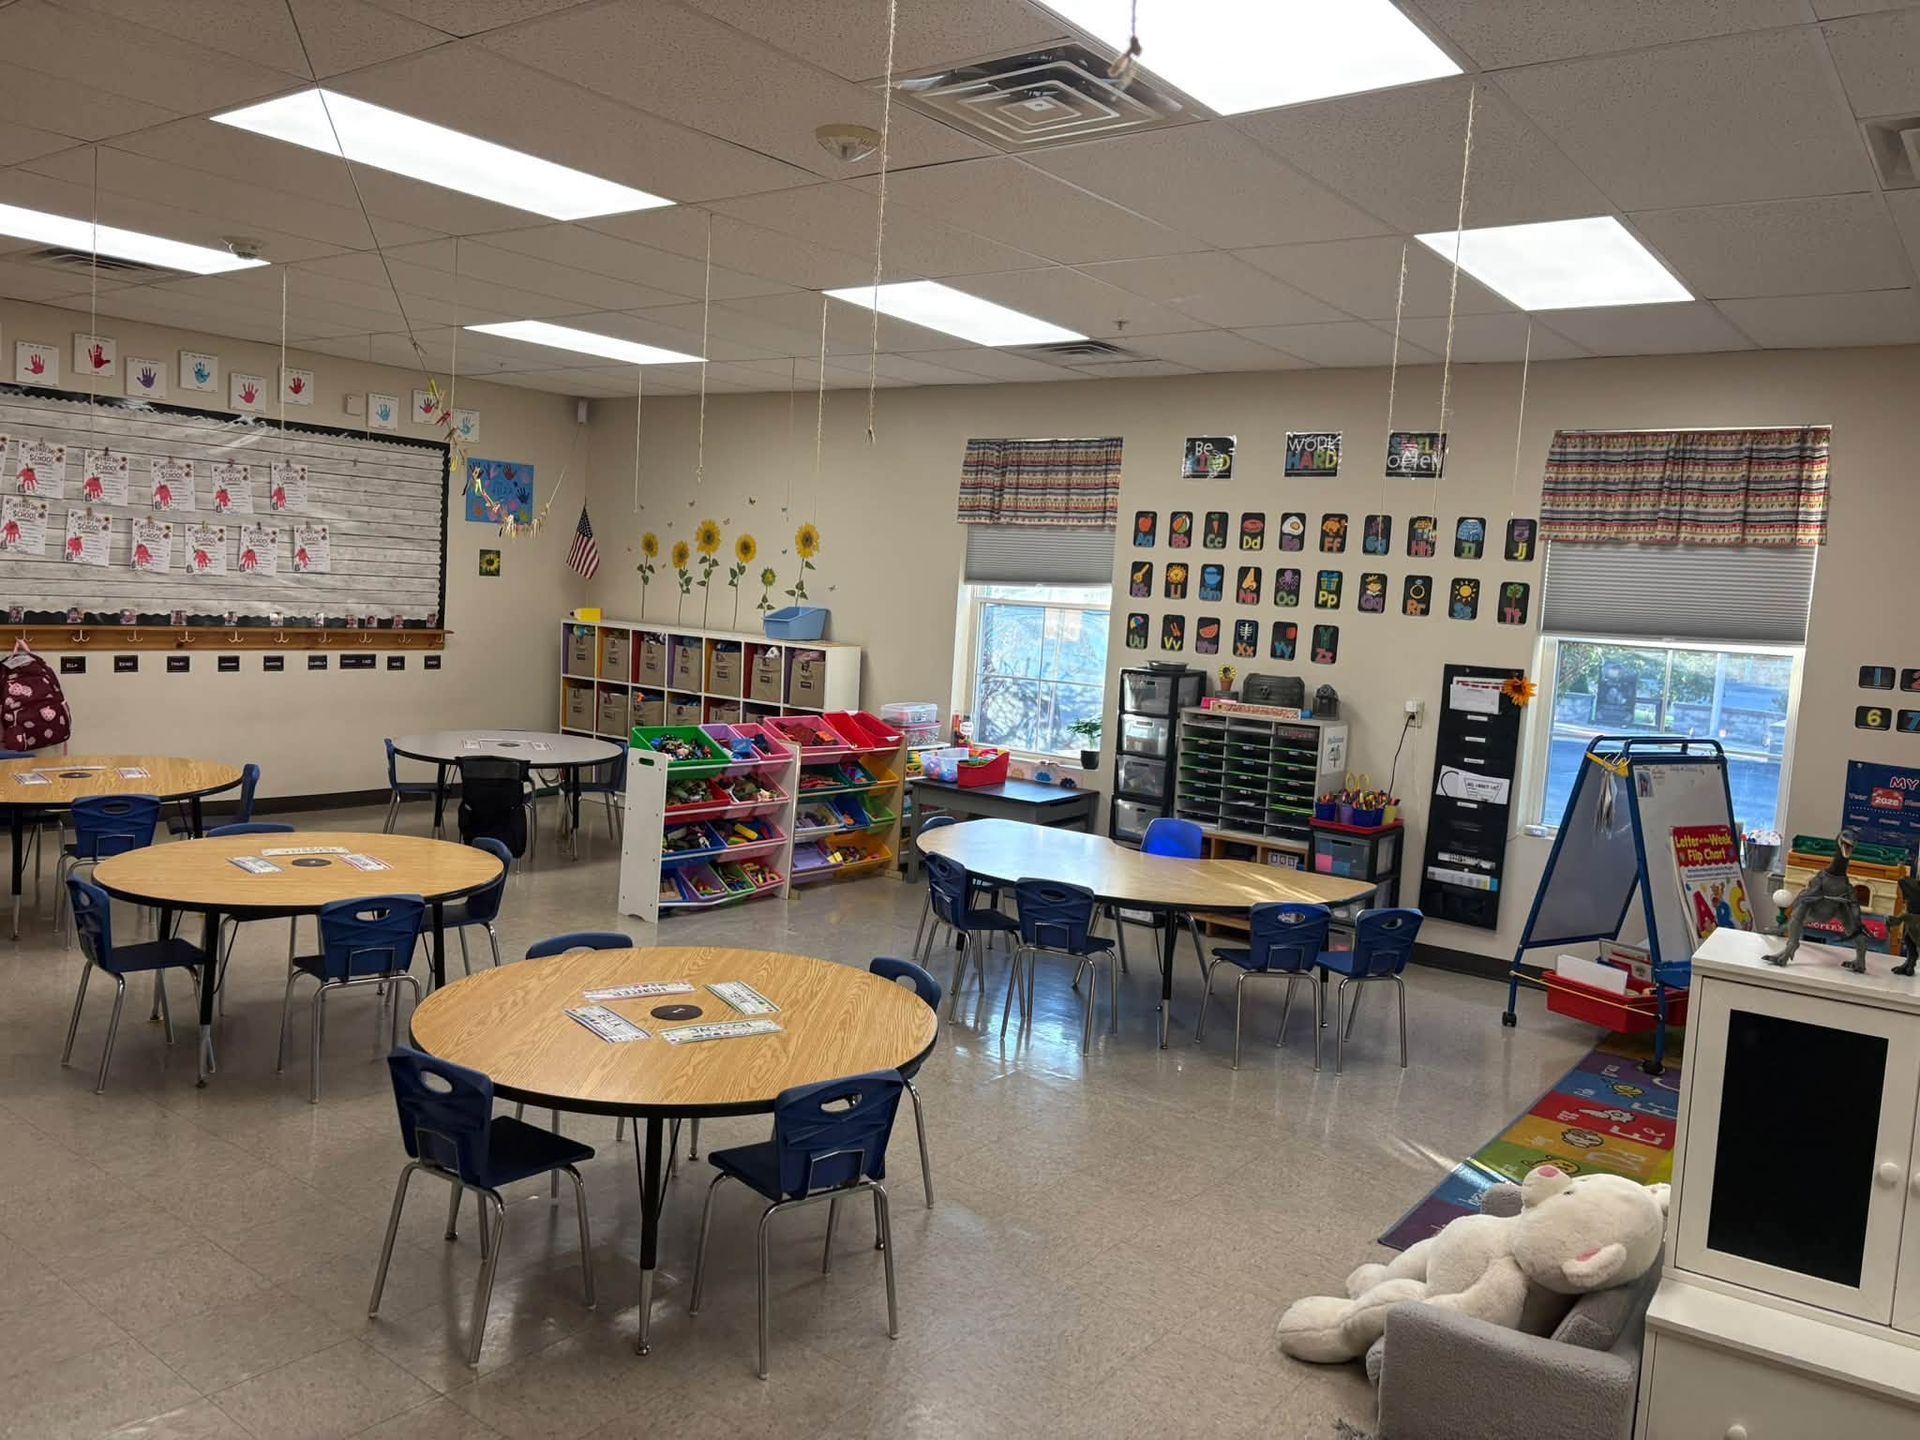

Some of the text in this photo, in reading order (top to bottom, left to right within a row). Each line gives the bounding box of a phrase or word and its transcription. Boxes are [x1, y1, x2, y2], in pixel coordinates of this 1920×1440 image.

[1287, 450, 1336, 469] HARD
[1207, 535, 1223, 547] Cc
[1243, 536, 1260, 549] Dd
[1277, 593, 1296, 605] Oo
[1318, 591, 1336, 607] Pp
[1163, 637, 1182, 650] Vv
[1236, 643, 1254, 657] Xx
[1867, 709, 1882, 726] 6
[1890, 776, 1919, 791] MY
[1675, 834, 1699, 848] Letter
[1688, 848, 1727, 864] Flip Chart
